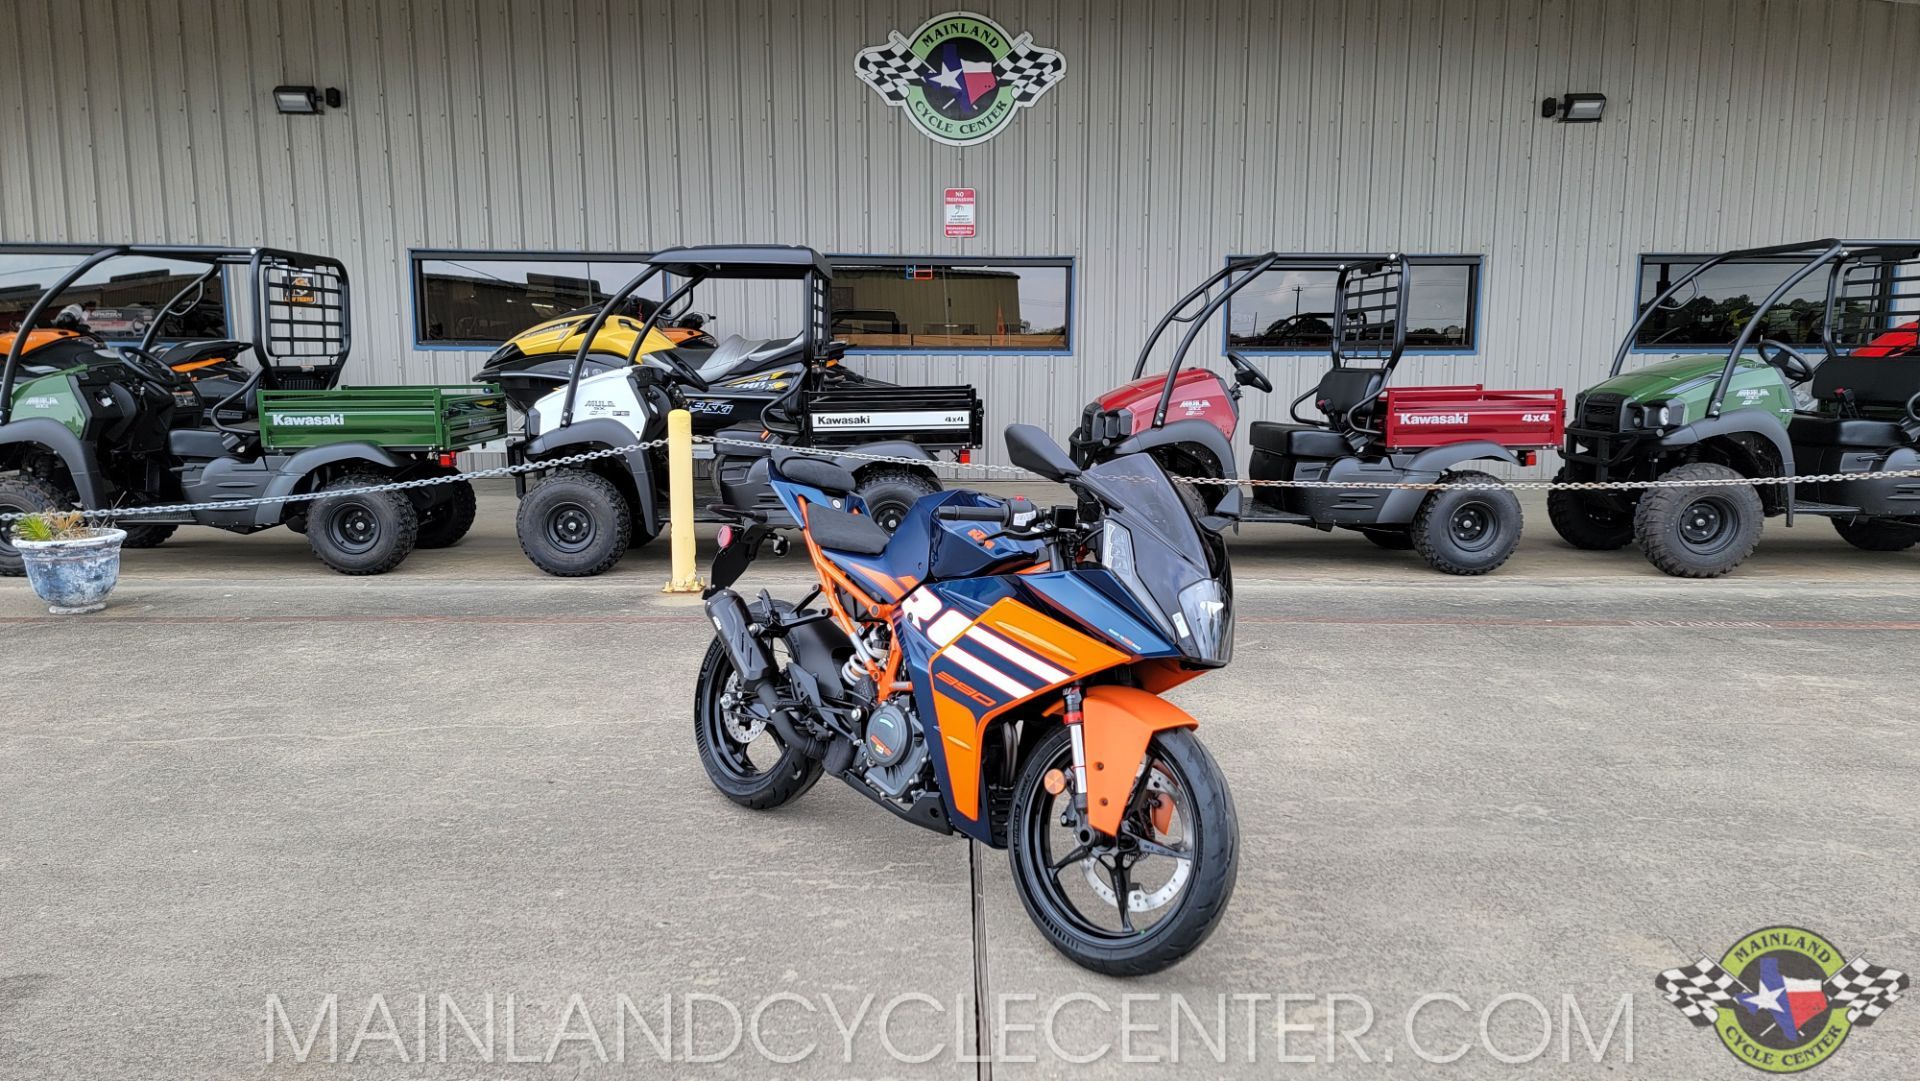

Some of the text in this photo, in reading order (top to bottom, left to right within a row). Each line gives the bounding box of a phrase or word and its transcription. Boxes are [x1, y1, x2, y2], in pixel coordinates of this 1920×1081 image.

[921, 23, 1000, 49] MAINLAND
[914, 100, 1008, 134] CYCLE CENTER
[272, 413, 345, 426] Kawasaki
[817, 415, 871, 425] Kawasaki
[1400, 413, 1551, 425] Kawasaki 4x4
[935, 671, 998, 707] 390
